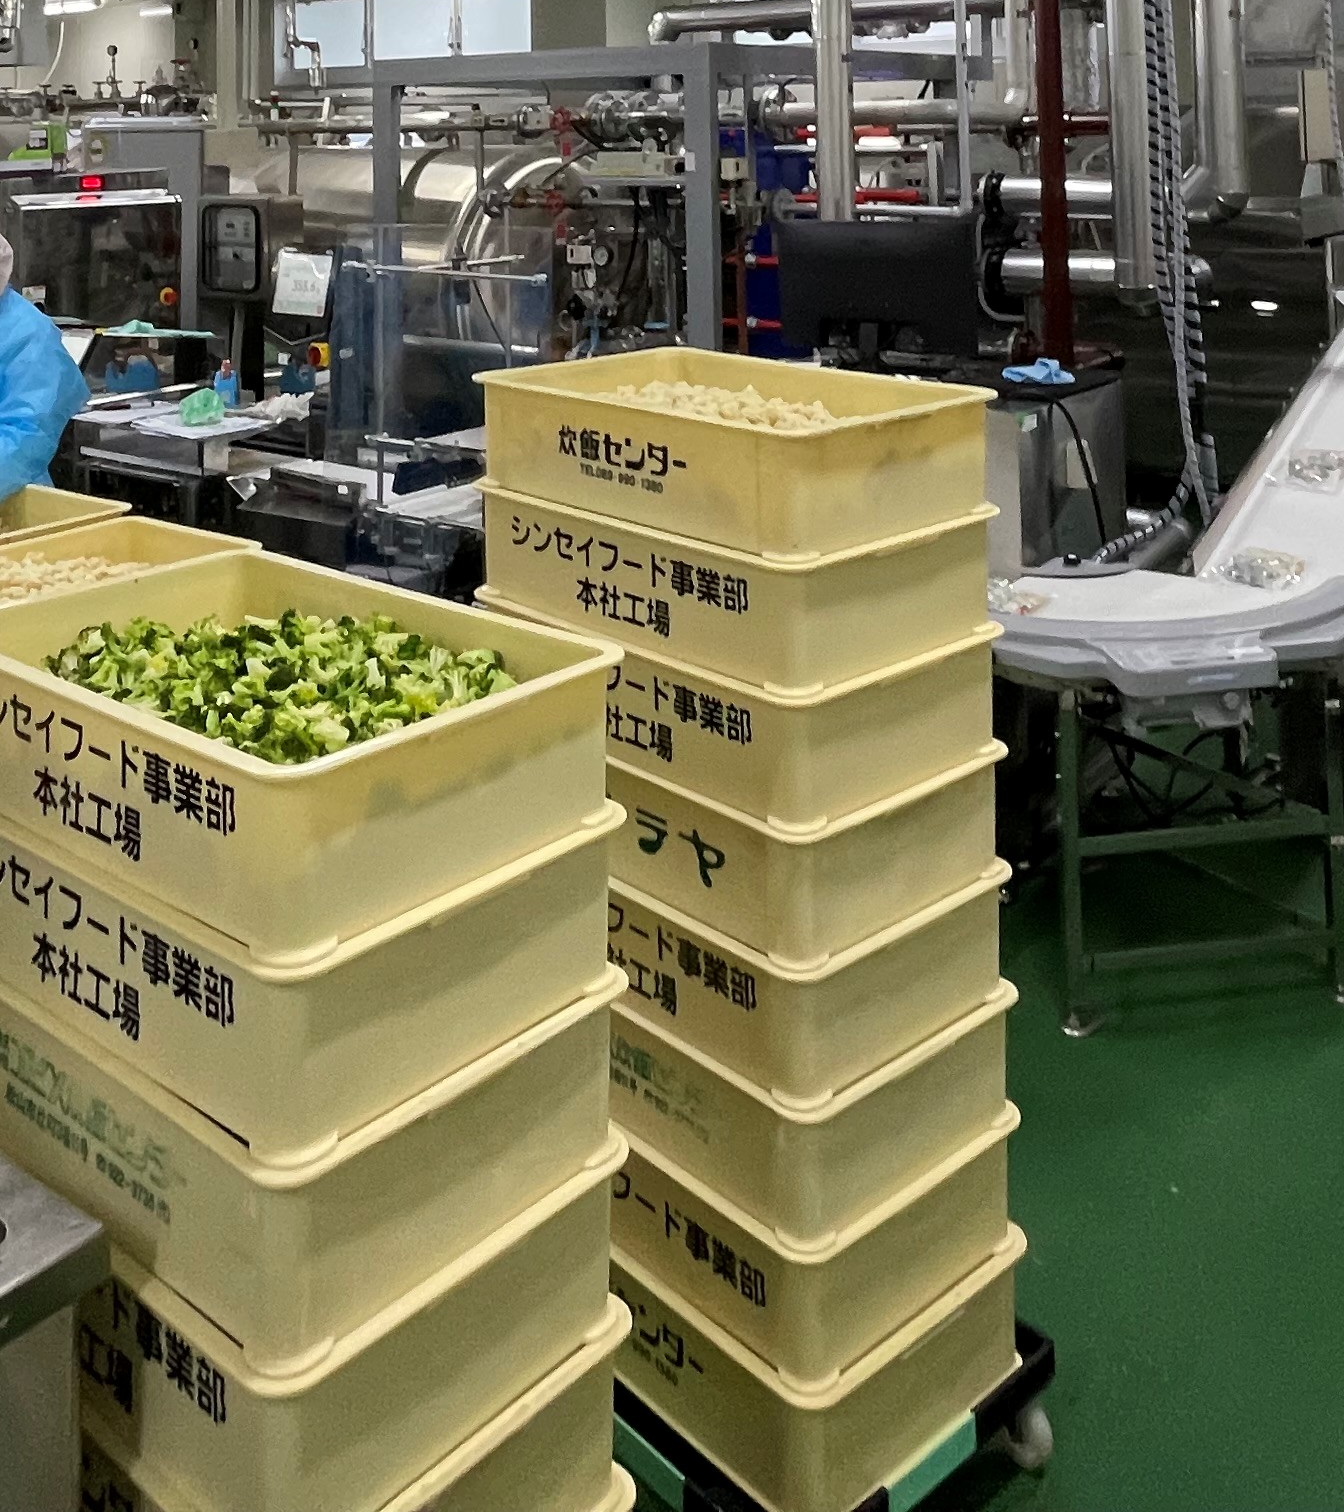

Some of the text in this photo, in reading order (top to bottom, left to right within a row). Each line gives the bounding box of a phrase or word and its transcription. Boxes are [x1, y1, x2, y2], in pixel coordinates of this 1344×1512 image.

[558, 424, 687, 476] 炊飯センター
[512, 516, 748, 614] シンセイフード事業部
[577, 577, 671, 637] 本社工場
[33, 766, 141, 862] 本社工場
[607, 793, 725, 887] ラヤ
[31, 932, 140, 1040] 本社工場
[96, 1280, 226, 1425] ド事業部
[618, 1286, 703, 1374] ンター
